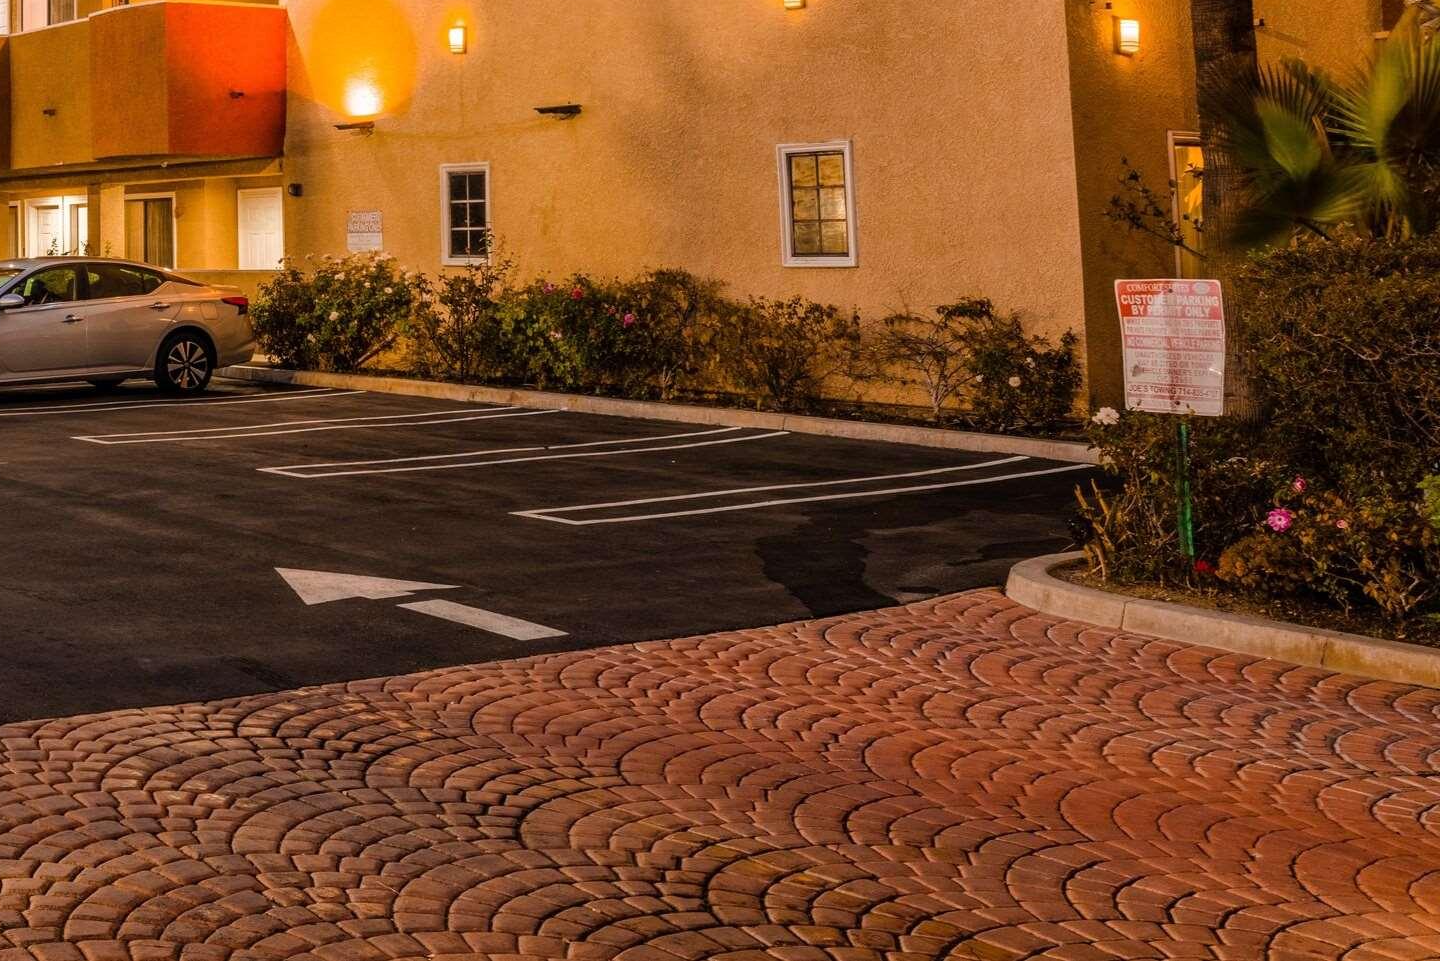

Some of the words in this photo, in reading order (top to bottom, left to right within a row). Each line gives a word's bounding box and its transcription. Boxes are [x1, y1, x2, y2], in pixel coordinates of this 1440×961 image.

[1177, 295, 1219, 306] PARKING
[1131, 305, 1145, 316] BY
[1185, 306, 1211, 317] ONLY
